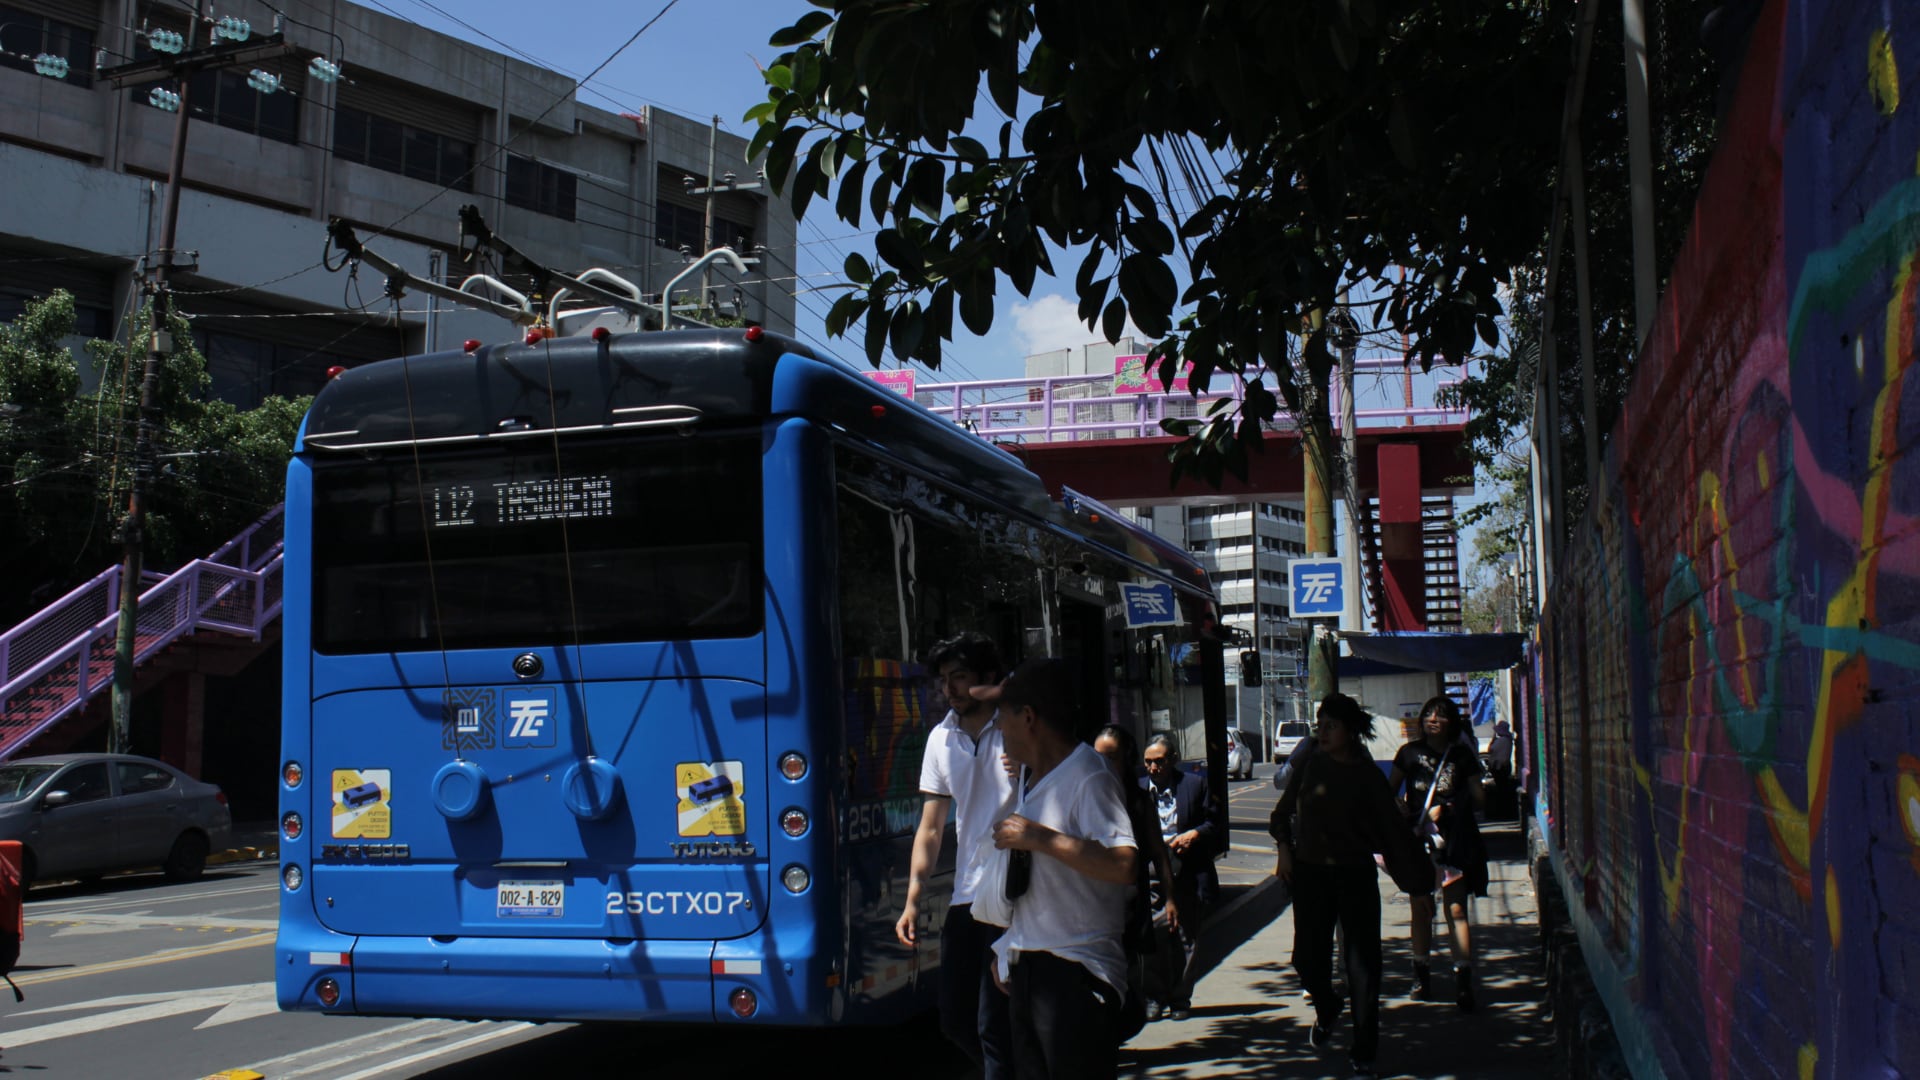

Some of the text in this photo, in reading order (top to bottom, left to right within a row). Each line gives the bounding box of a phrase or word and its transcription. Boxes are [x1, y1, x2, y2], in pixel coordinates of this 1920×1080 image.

[434, 485, 475, 527] L12
[668, 841, 756, 858] YUTONG
[500, 890, 562, 906] 002-A-829
[606, 891, 744, 915] 25CTX07
